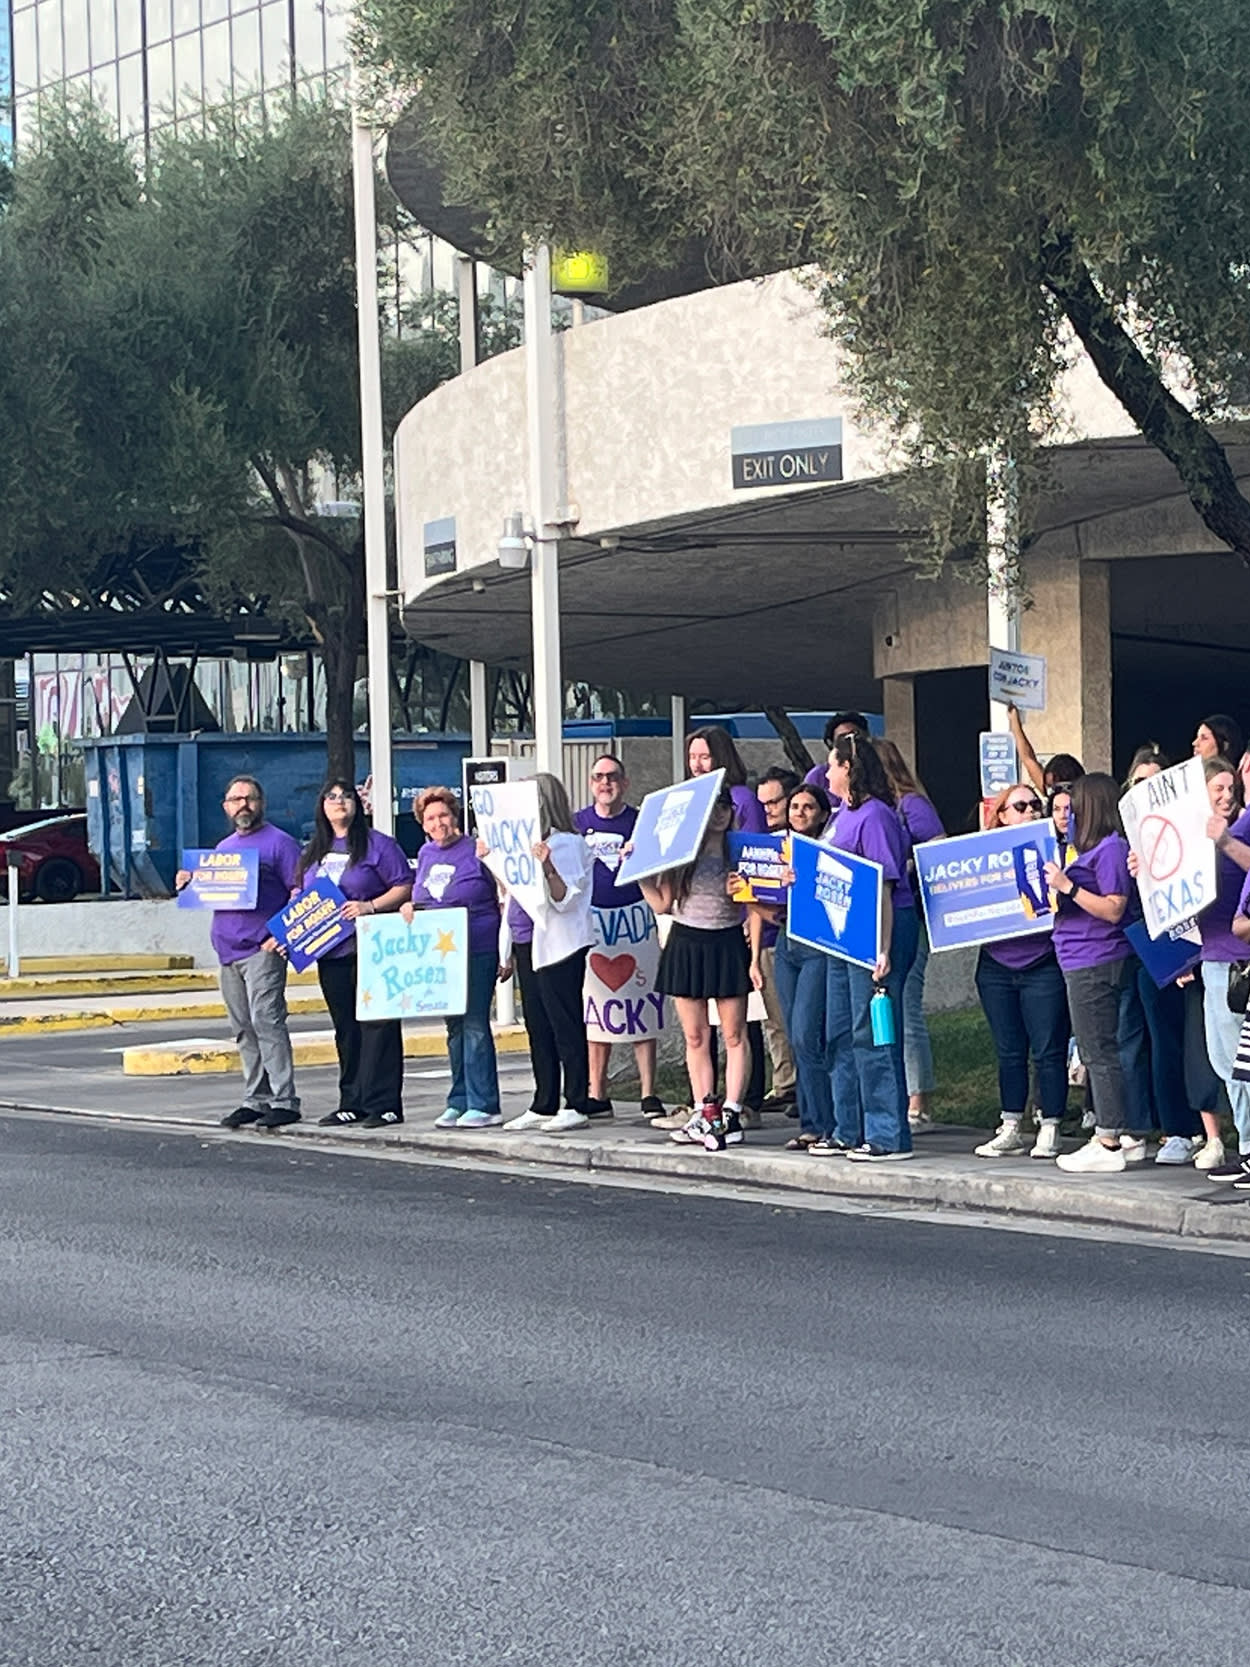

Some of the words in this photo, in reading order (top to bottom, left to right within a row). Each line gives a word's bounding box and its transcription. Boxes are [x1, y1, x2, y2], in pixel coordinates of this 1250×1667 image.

[743, 456, 775, 480] EXIT
[780, 453, 829, 478] ONLY
[473, 789, 495, 817] GO
[484, 818, 536, 856] JACKY
[199, 853, 242, 868] LABOR
[925, 854, 984, 883] JACKY
[192, 870, 213, 882] FOR
[815, 870, 853, 894] JACKY
[980, 872, 1001, 884] FOR
[281, 890, 322, 928] LABOR
[286, 923, 305, 946] FOR
[303, 897, 337, 930] ROSEN
[371, 922, 433, 966] Jacky
[381, 965, 448, 1001] Rosen
[584, 992, 667, 1035] ACKY
